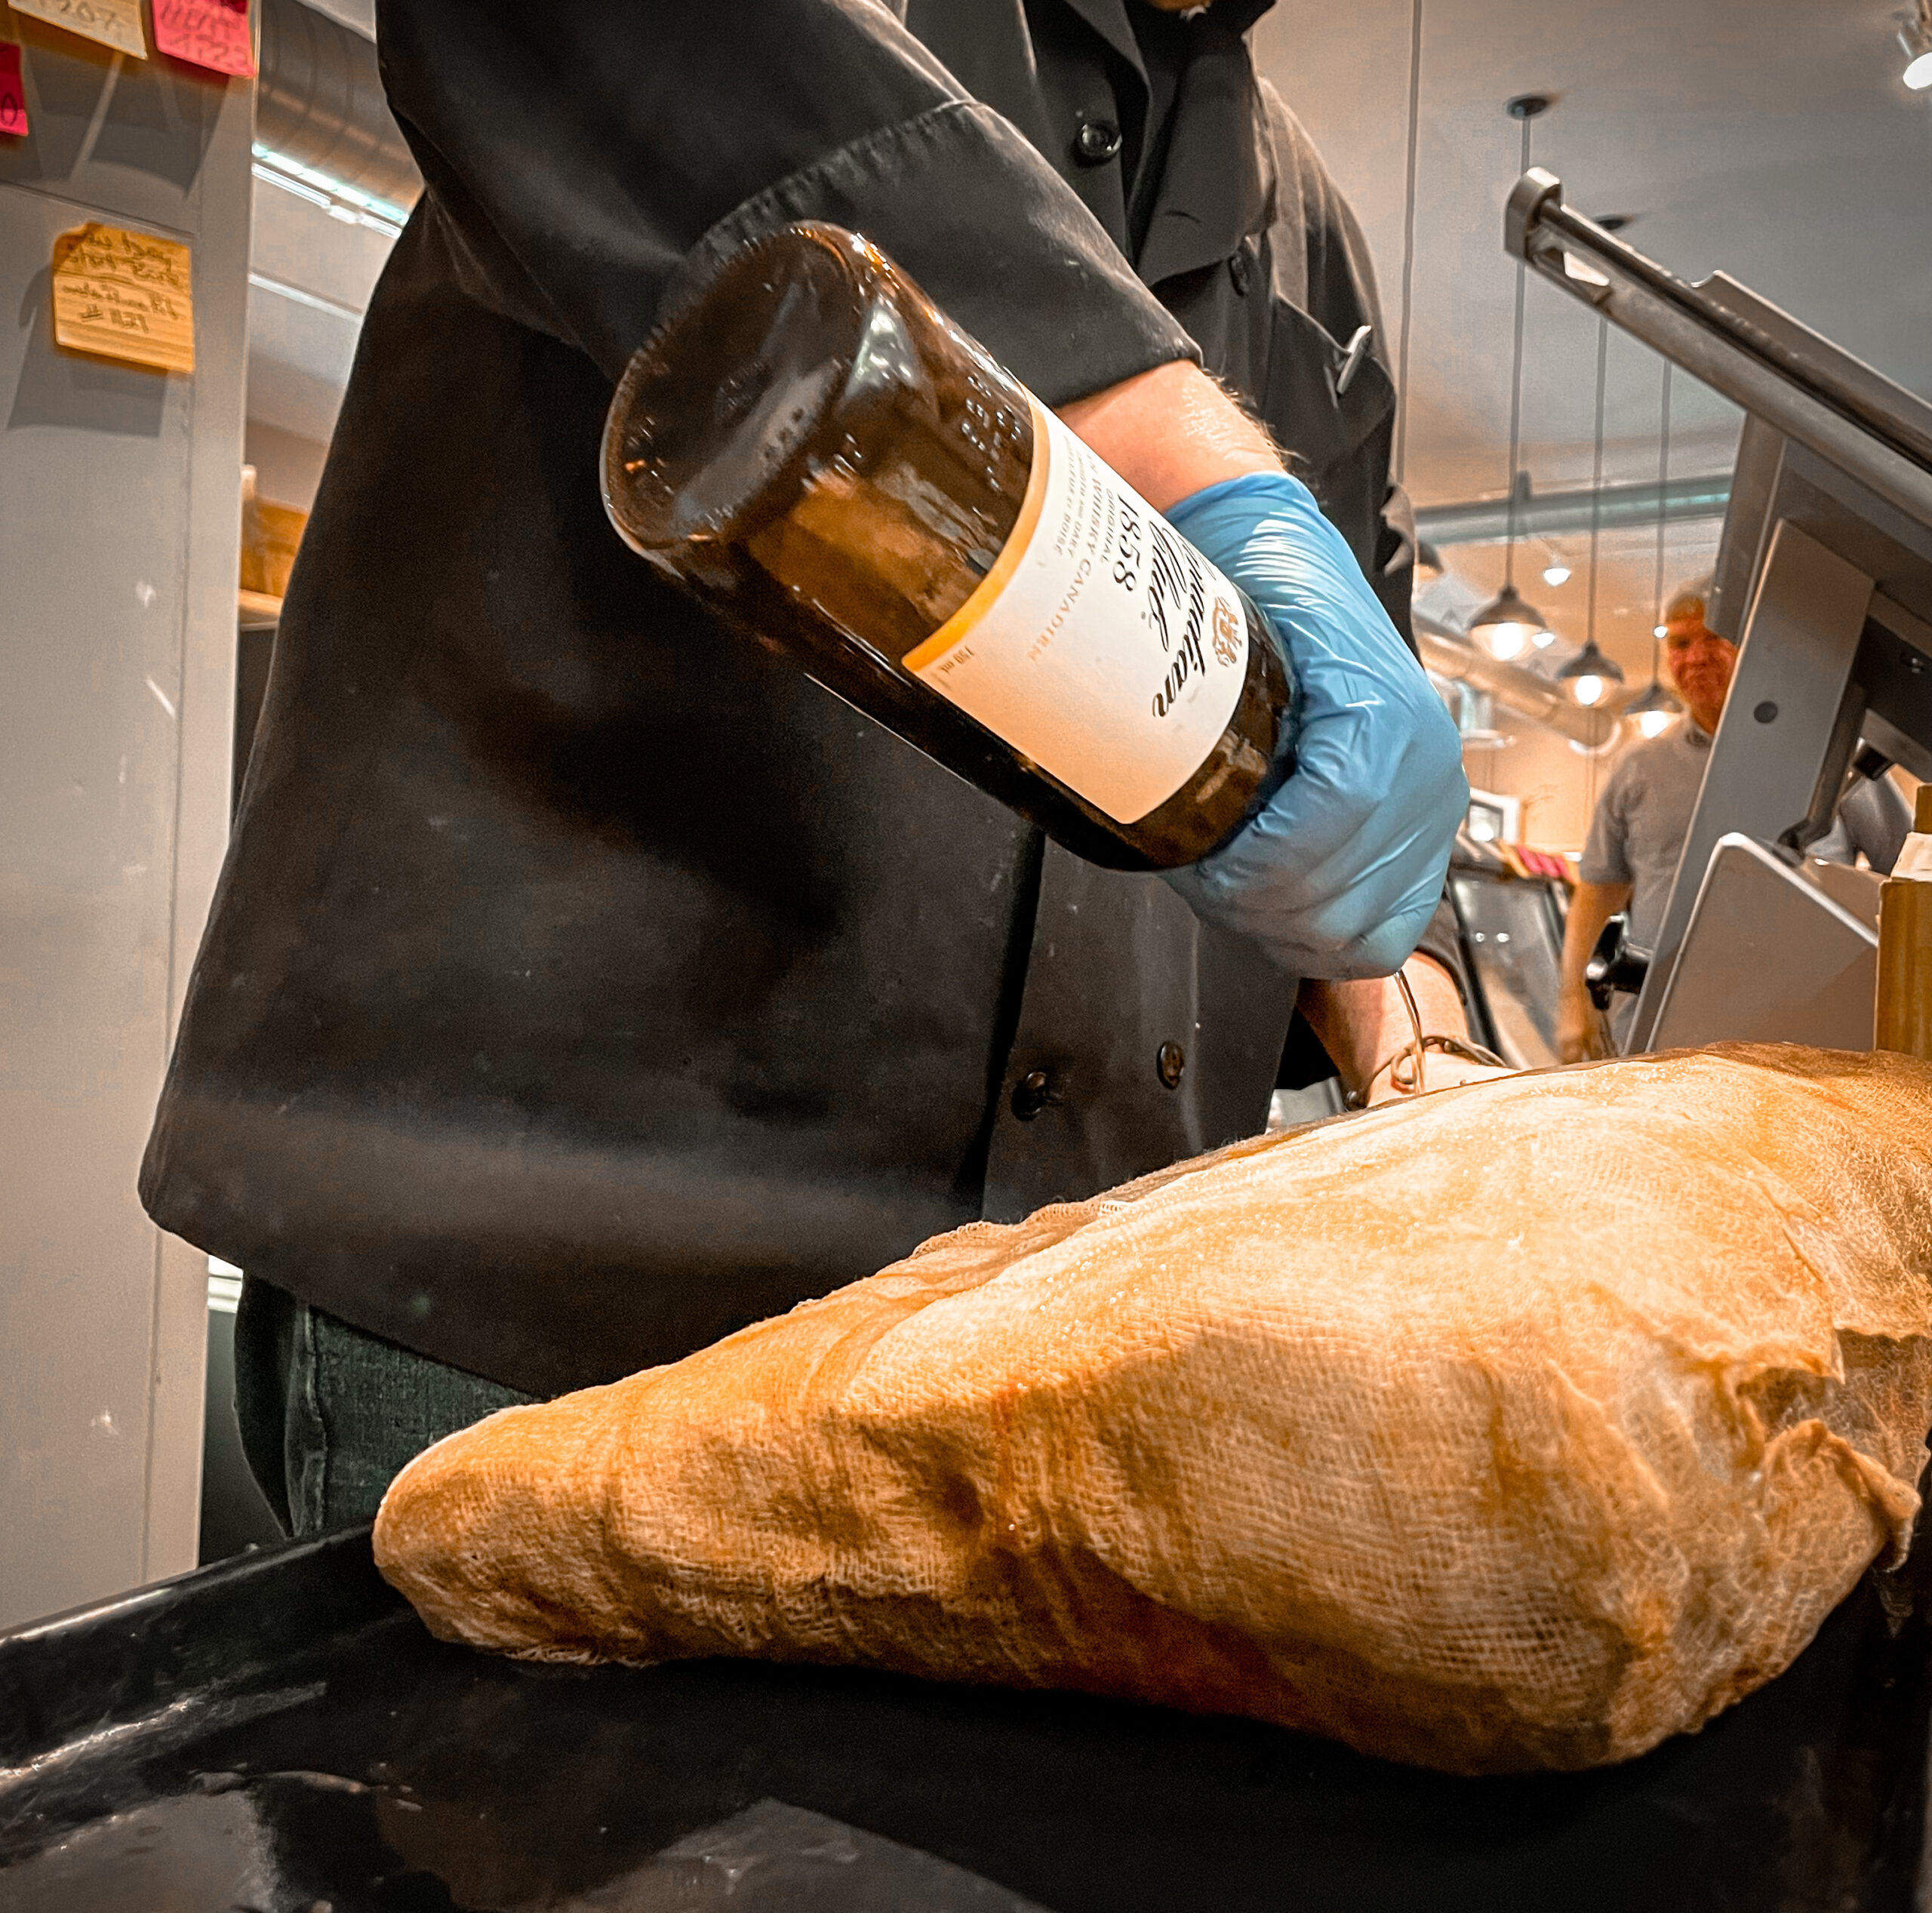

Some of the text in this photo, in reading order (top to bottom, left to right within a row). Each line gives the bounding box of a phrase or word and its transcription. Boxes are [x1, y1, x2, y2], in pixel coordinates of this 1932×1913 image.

[1026, 478, 1103, 663] WHISKY CANADIEN
[1066, 521, 1082, 559] OAKY
[1100, 488, 1115, 564] ORIGINAL
[1113, 494, 1142, 592] 1858
[1148, 521, 1187, 652] Club
